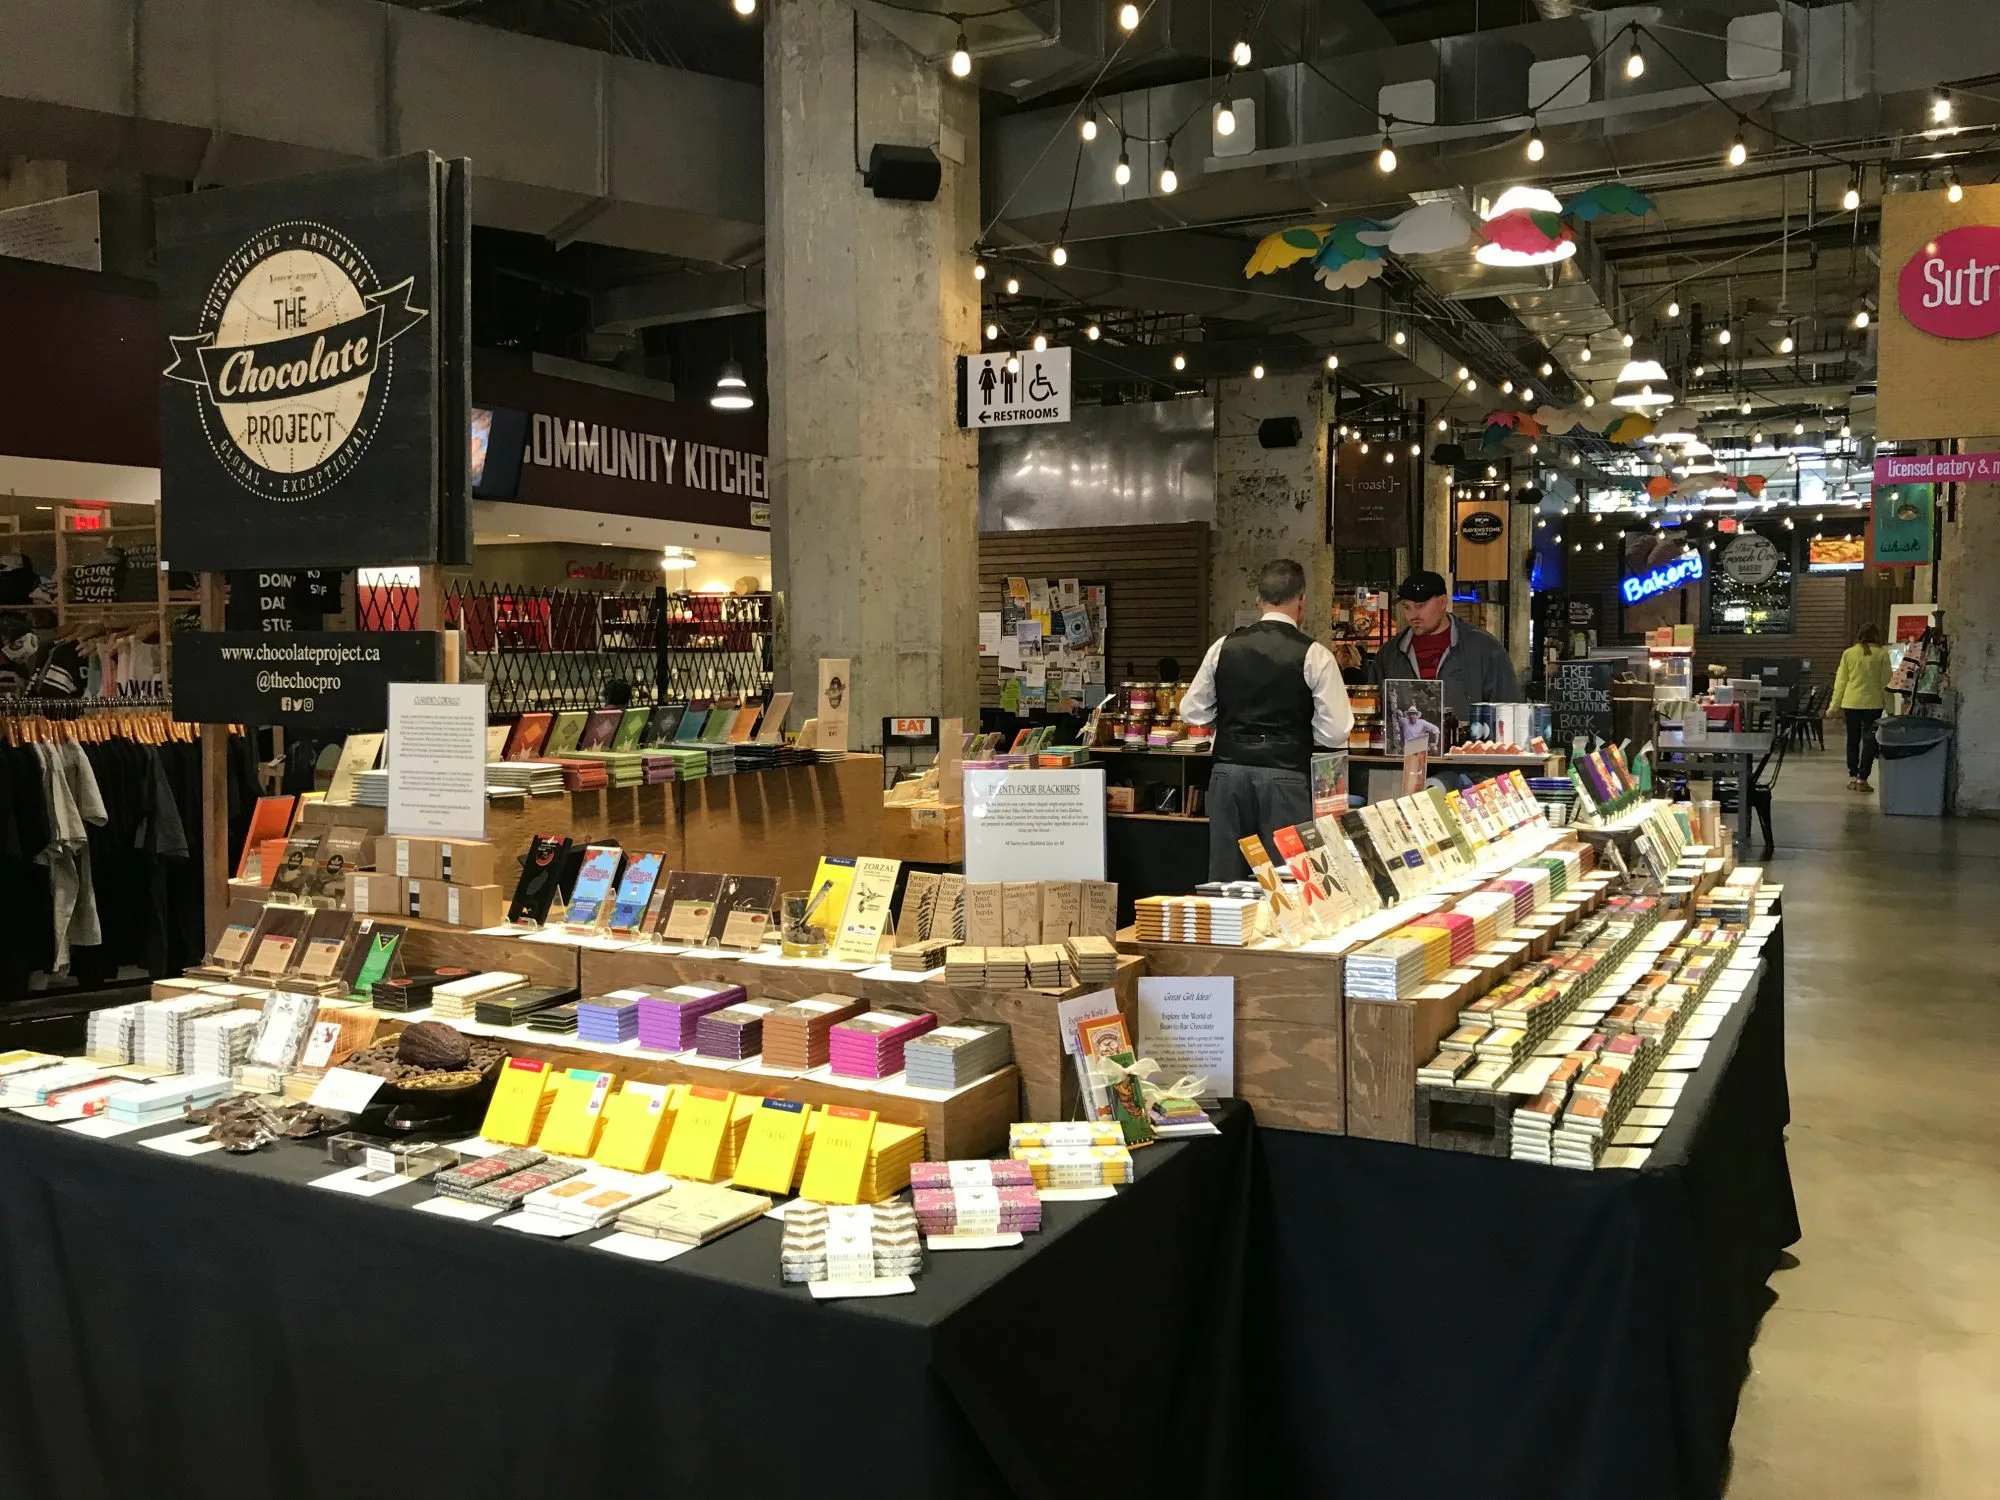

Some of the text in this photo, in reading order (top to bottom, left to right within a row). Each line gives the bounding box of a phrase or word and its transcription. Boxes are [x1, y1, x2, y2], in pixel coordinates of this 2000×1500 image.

[209, 232, 367, 321] SUSTAINABLE ARTISANAL
[273, 296, 308, 330] THE
[219, 335, 369, 397] Chocolate
[994, 407, 1059, 421] RESTROOMS
[246, 412, 336, 445] PROJECT
[220, 427, 367, 493] GLOBAL EXCEPTIONAL
[1888, 458, 1934, 477] licensed
[1937, 459, 1976, 479] eatery
[1978, 458, 1989, 474] &
[259, 573, 297, 588] DOIN'
[1623, 558, 1703, 602] Bakery
[221, 643, 380, 666] www.chocolateproject.ca
[1561, 665, 1593, 679] FREE
[257, 670, 341, 694] @thechocpro
[1548, 678, 1594, 690] HERBAL
[1562, 689, 1610, 702] MEDICINE
[897, 719, 926, 732] EAT
[1560, 713, 1595, 729] BOOK
[1038, 784, 1081, 795] BLACKBIRDS
[863, 863, 895, 873] ZORZAL
[1164, 992, 1212, 1001] Great Gift Idea!
[1161, 1012, 1213, 1021] Explore the World of
[1189, 1022, 1215, 1030] Chocolate
